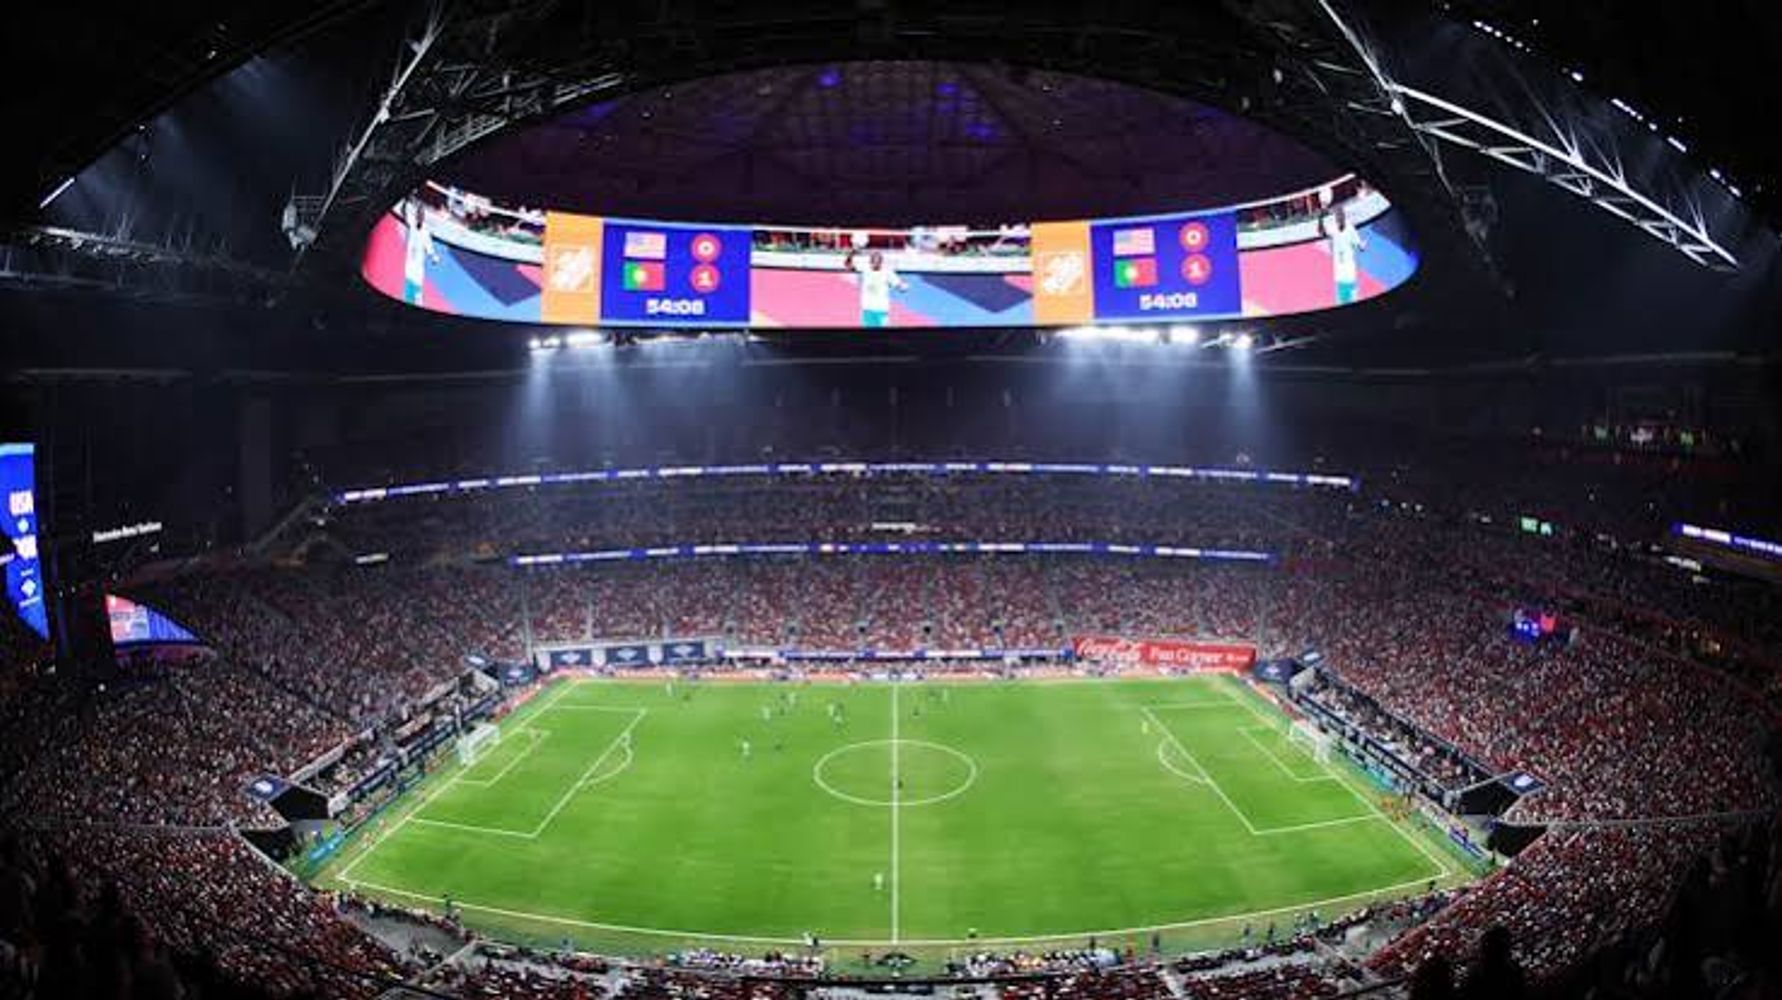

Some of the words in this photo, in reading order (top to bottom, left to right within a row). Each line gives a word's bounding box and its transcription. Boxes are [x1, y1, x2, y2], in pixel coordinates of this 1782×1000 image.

[1186, 228, 1201, 246] 0
[698, 240, 715, 258] 0
[698, 271, 714, 287] 1
[1188, 262, 1203, 279] 1
